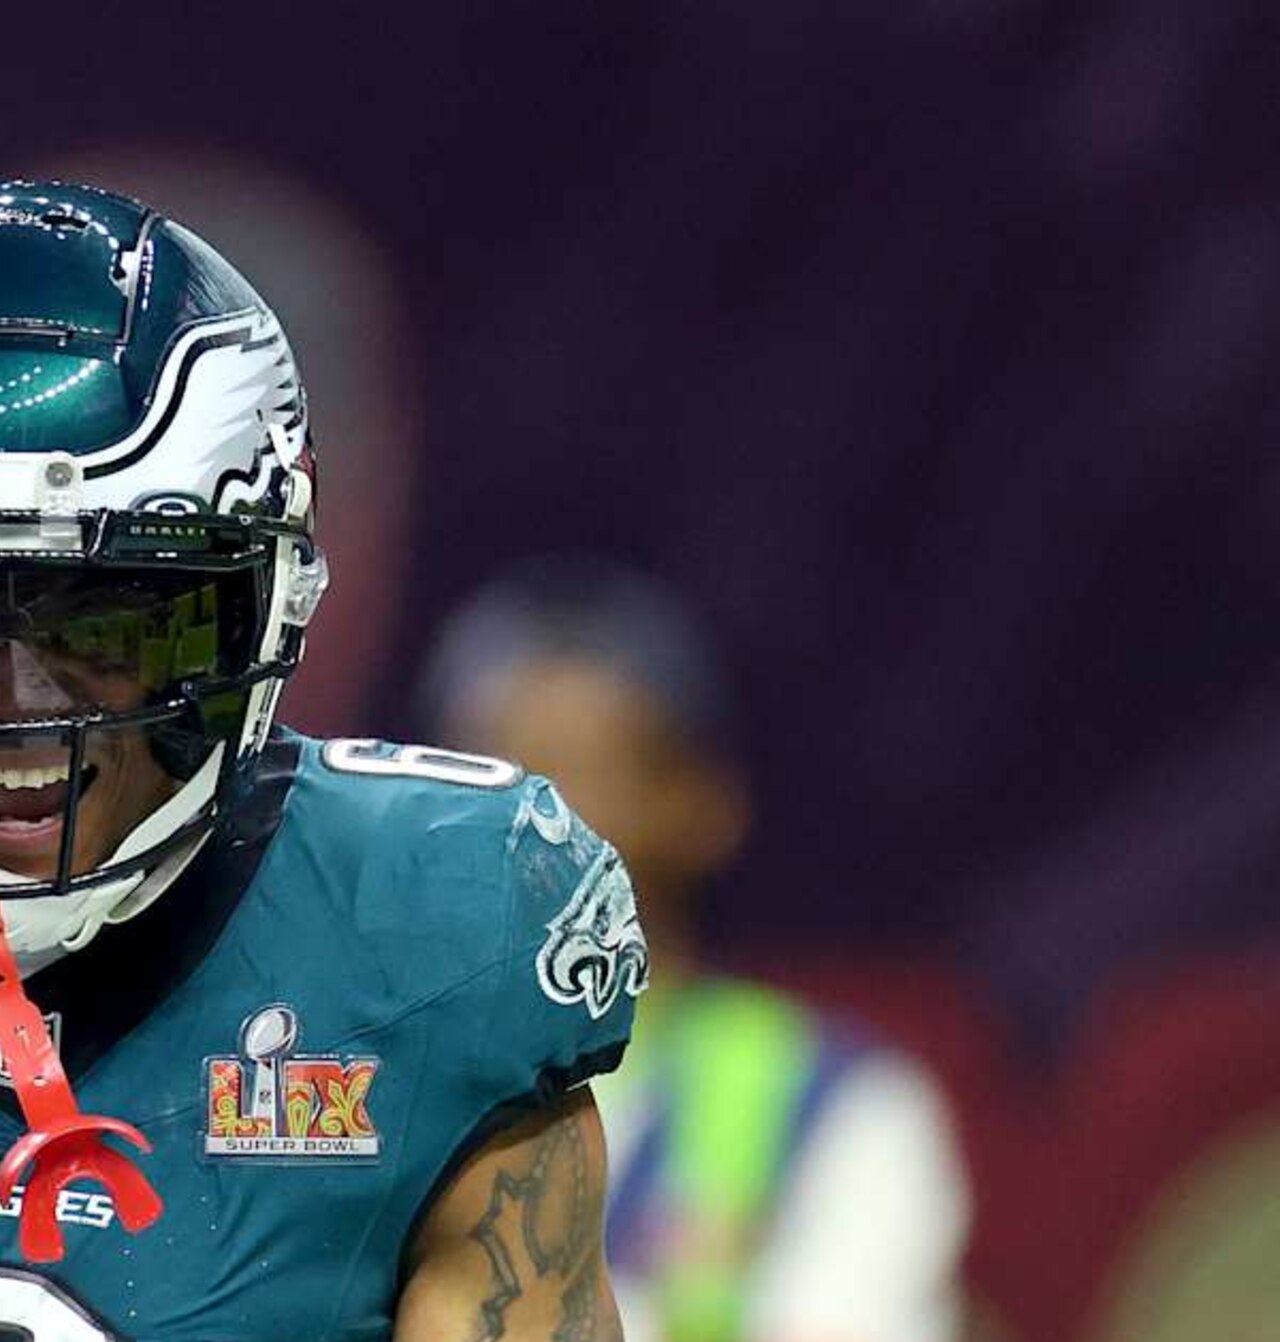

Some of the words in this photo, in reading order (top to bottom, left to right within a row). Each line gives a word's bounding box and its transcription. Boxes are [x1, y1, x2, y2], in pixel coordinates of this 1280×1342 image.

[320, 739, 524, 788] 6
[224, 1139, 296, 1151] SUPER
[303, 1139, 361, 1151] BOWL
